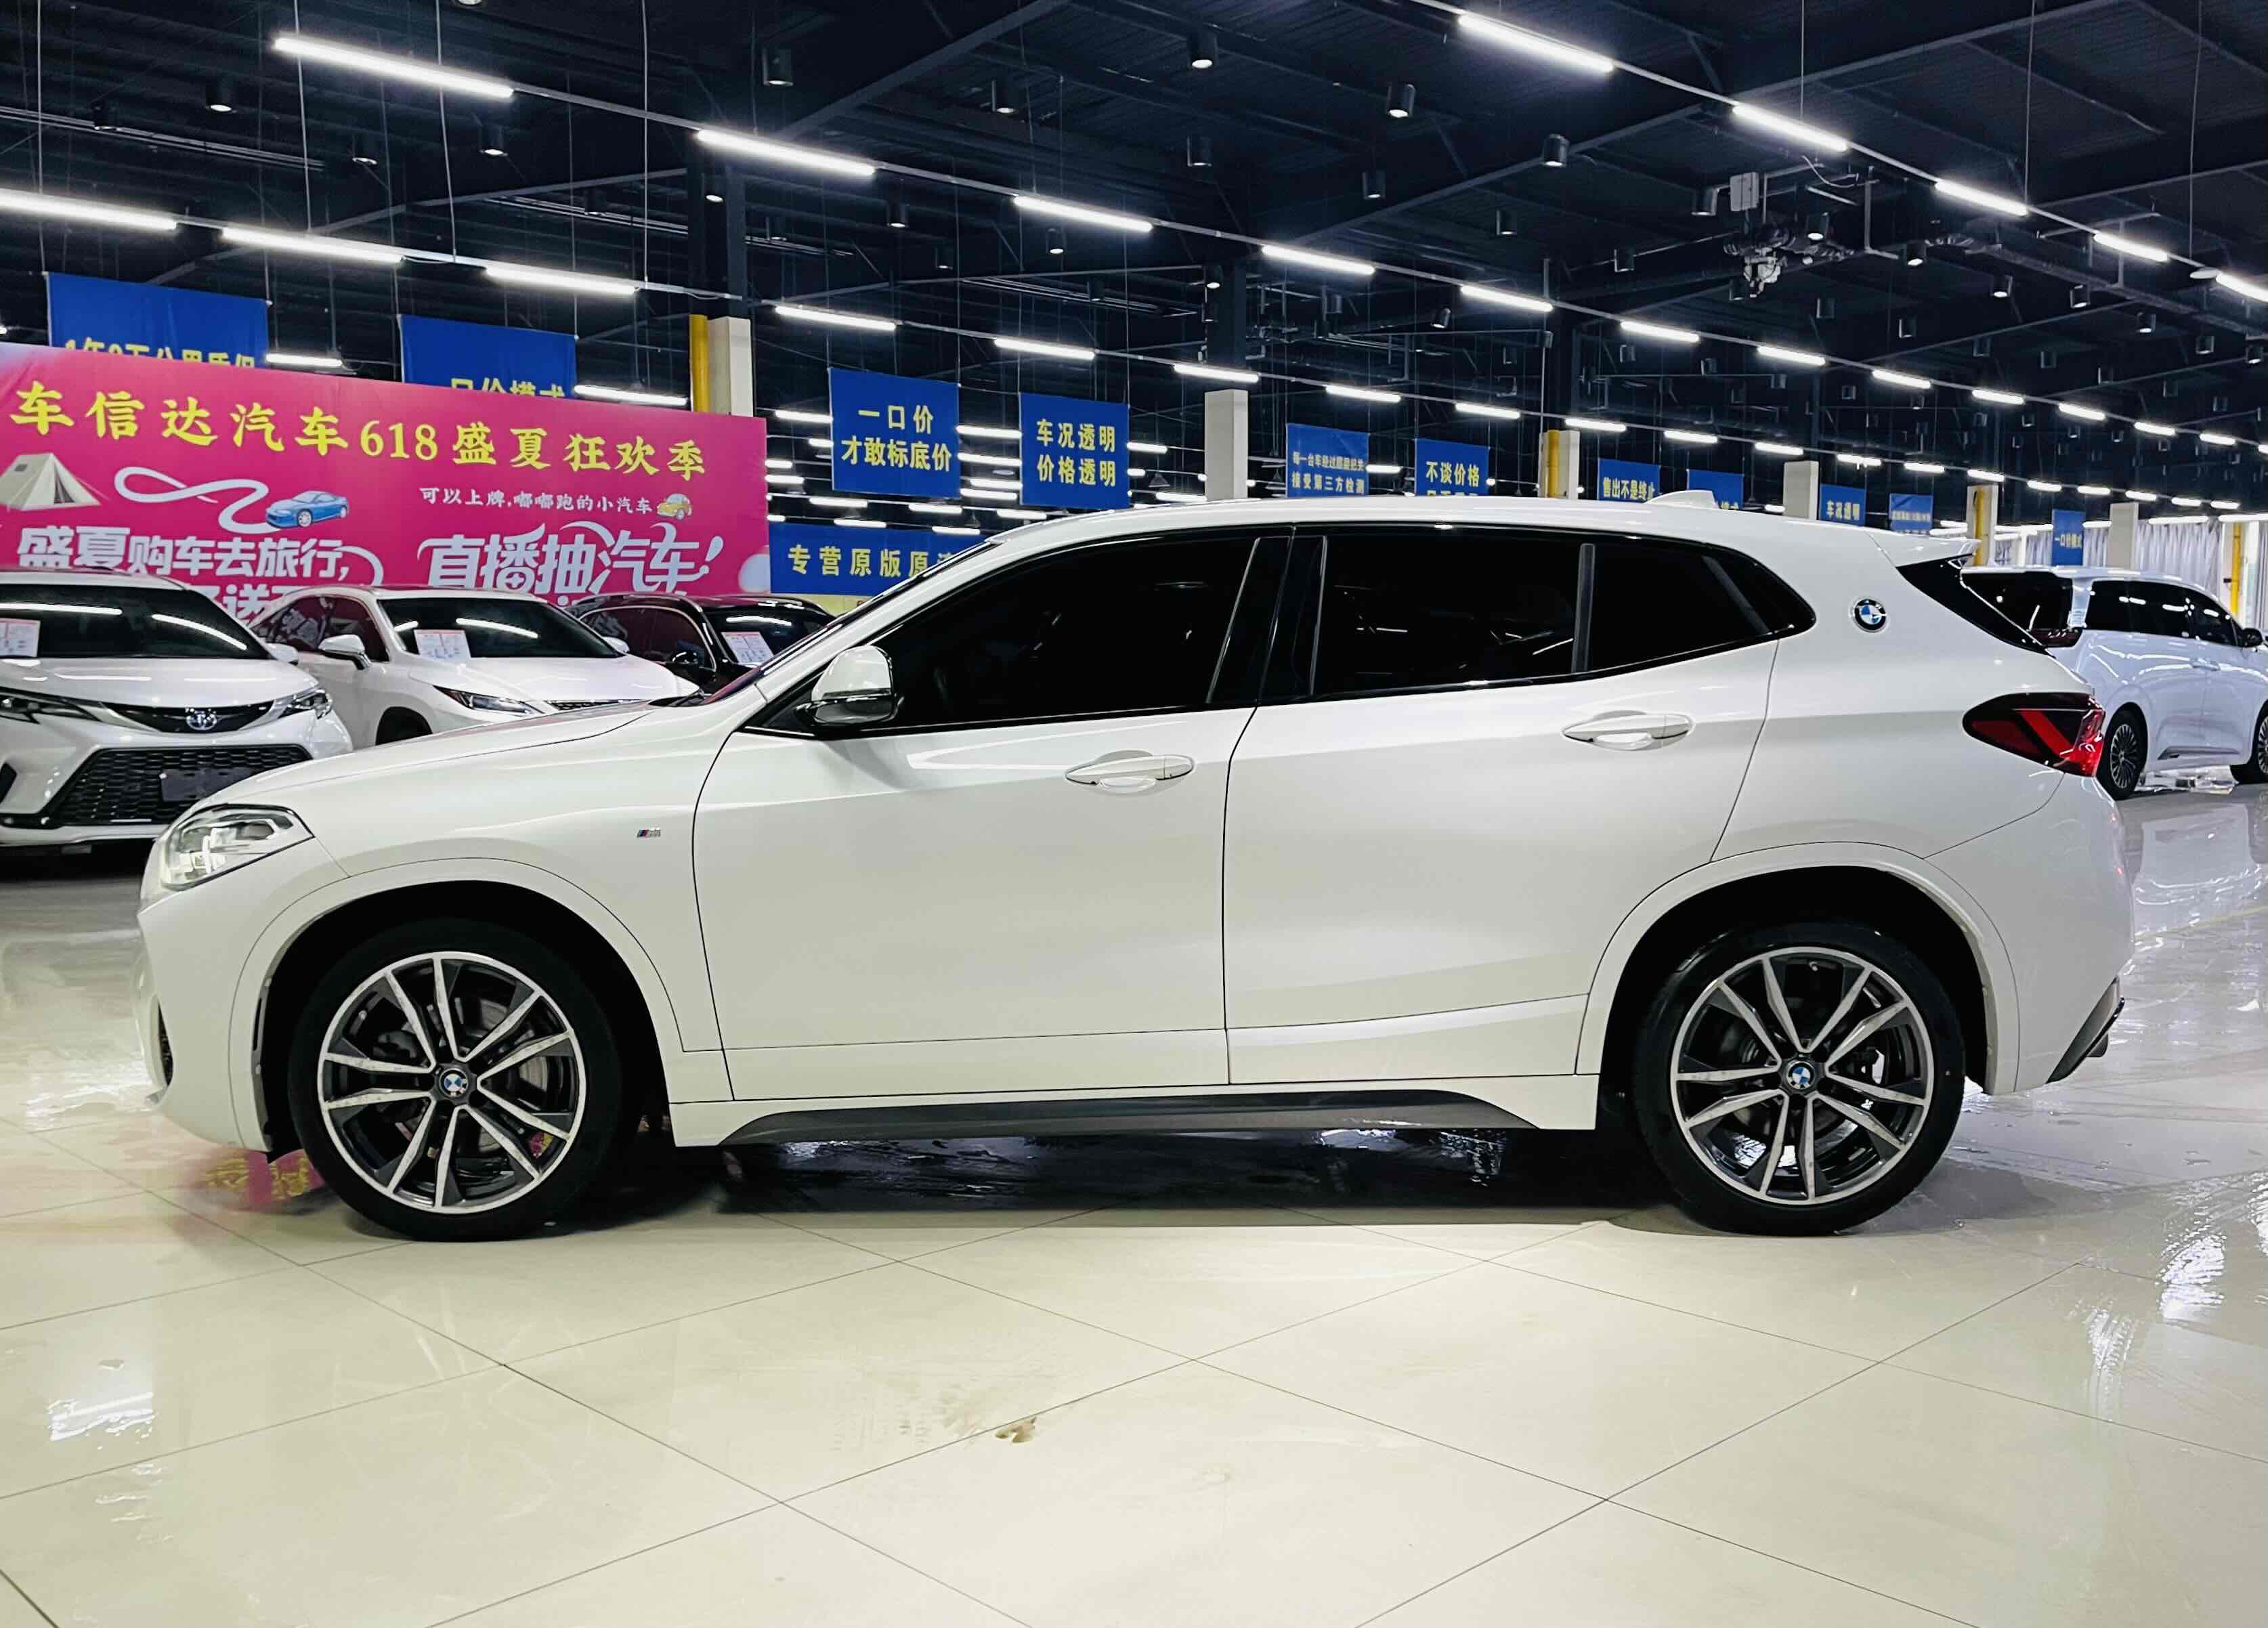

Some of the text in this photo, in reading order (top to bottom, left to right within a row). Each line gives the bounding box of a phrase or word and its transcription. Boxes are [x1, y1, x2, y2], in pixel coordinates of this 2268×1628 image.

[9, 380, 706, 481] 车信达汽车618盛夏狂欢季
[857, 404, 934, 435] 一口价
[1035, 418, 1117, 453] 车况透明
[840, 435, 952, 473] 才敢标底价
[1036, 453, 1117, 488] 价格透明
[1426, 460, 1480, 488] 不谈价格
[788, 544, 955, 577] 专营原版原
